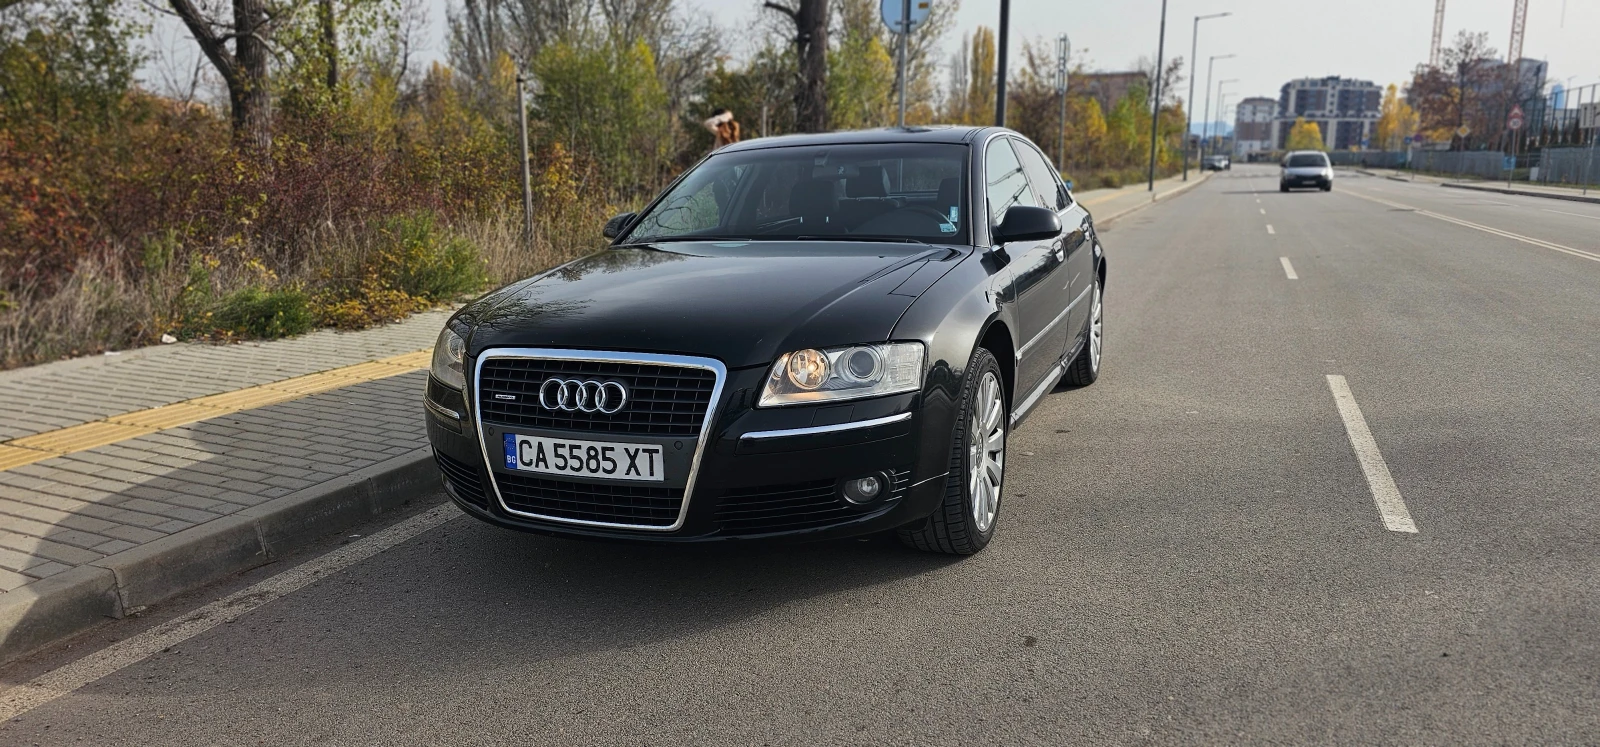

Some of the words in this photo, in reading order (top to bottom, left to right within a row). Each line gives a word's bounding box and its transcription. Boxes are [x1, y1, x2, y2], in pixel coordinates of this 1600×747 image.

[506, 455, 516, 464] BG
[519, 439, 549, 469] CA
[553, 442, 618, 475] 5585
[623, 447, 660, 477] XT
